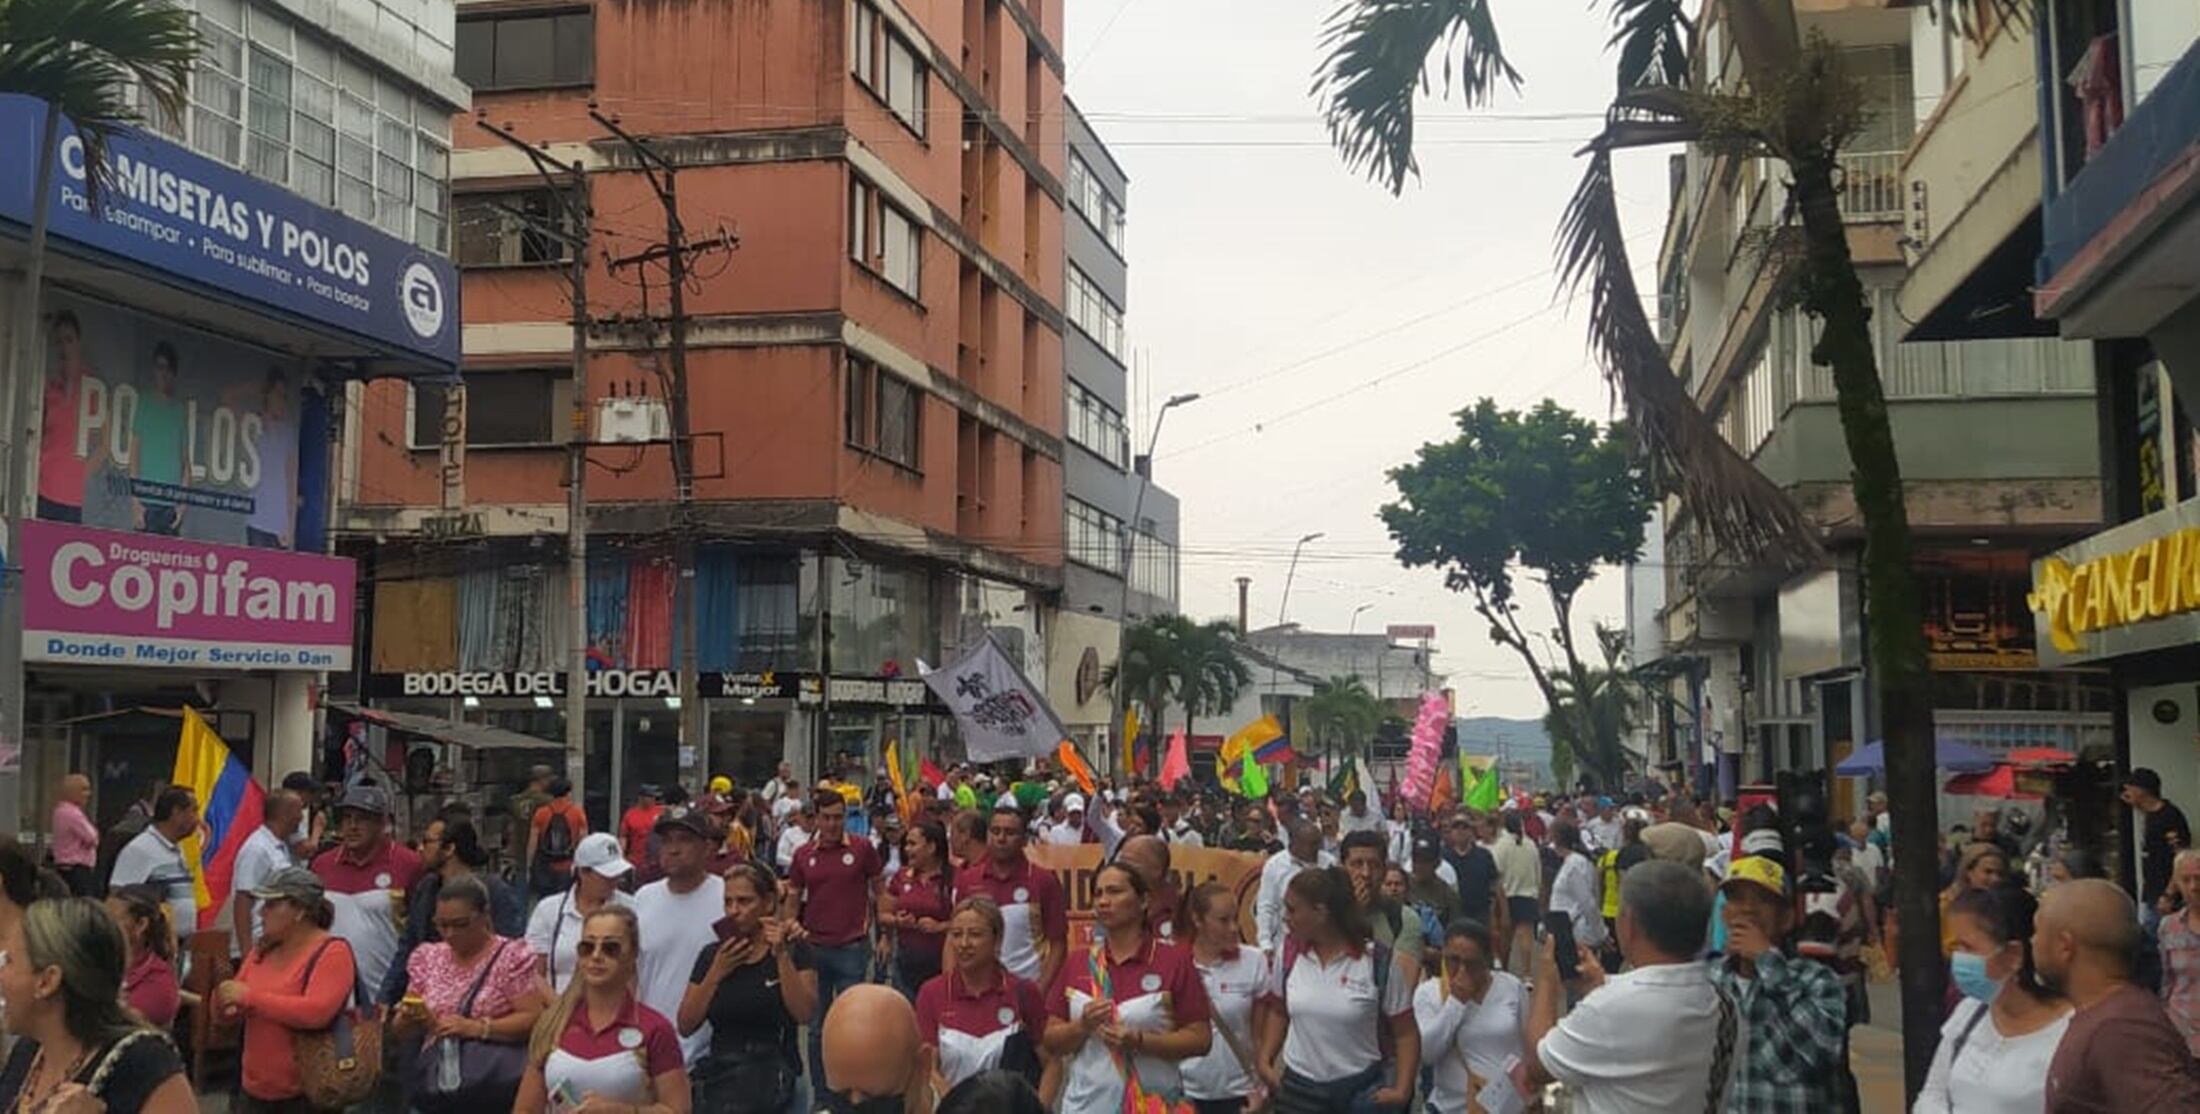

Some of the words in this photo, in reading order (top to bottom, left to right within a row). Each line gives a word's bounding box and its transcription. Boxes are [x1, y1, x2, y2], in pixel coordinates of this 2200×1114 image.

[203, 236, 235, 265] Para
[237, 253, 293, 286] sublimar
[306, 275, 333, 300] Para
[255, 209, 275, 250] Y
[283, 220, 370, 286] POLOS
[51, 541, 337, 629] Copifam
[2067, 527, 2200, 633] CANGUR
[47, 638, 126, 659] Donde
[136, 643, 199, 665] Mejor
[208, 648, 292, 665] Servicio
[298, 650, 332, 665] Dan
[404, 671, 509, 695] BODEGA
[514, 671, 564, 695] DEL
[584, 669, 682, 697] HOGA
[722, 684, 782, 698] Mayor
